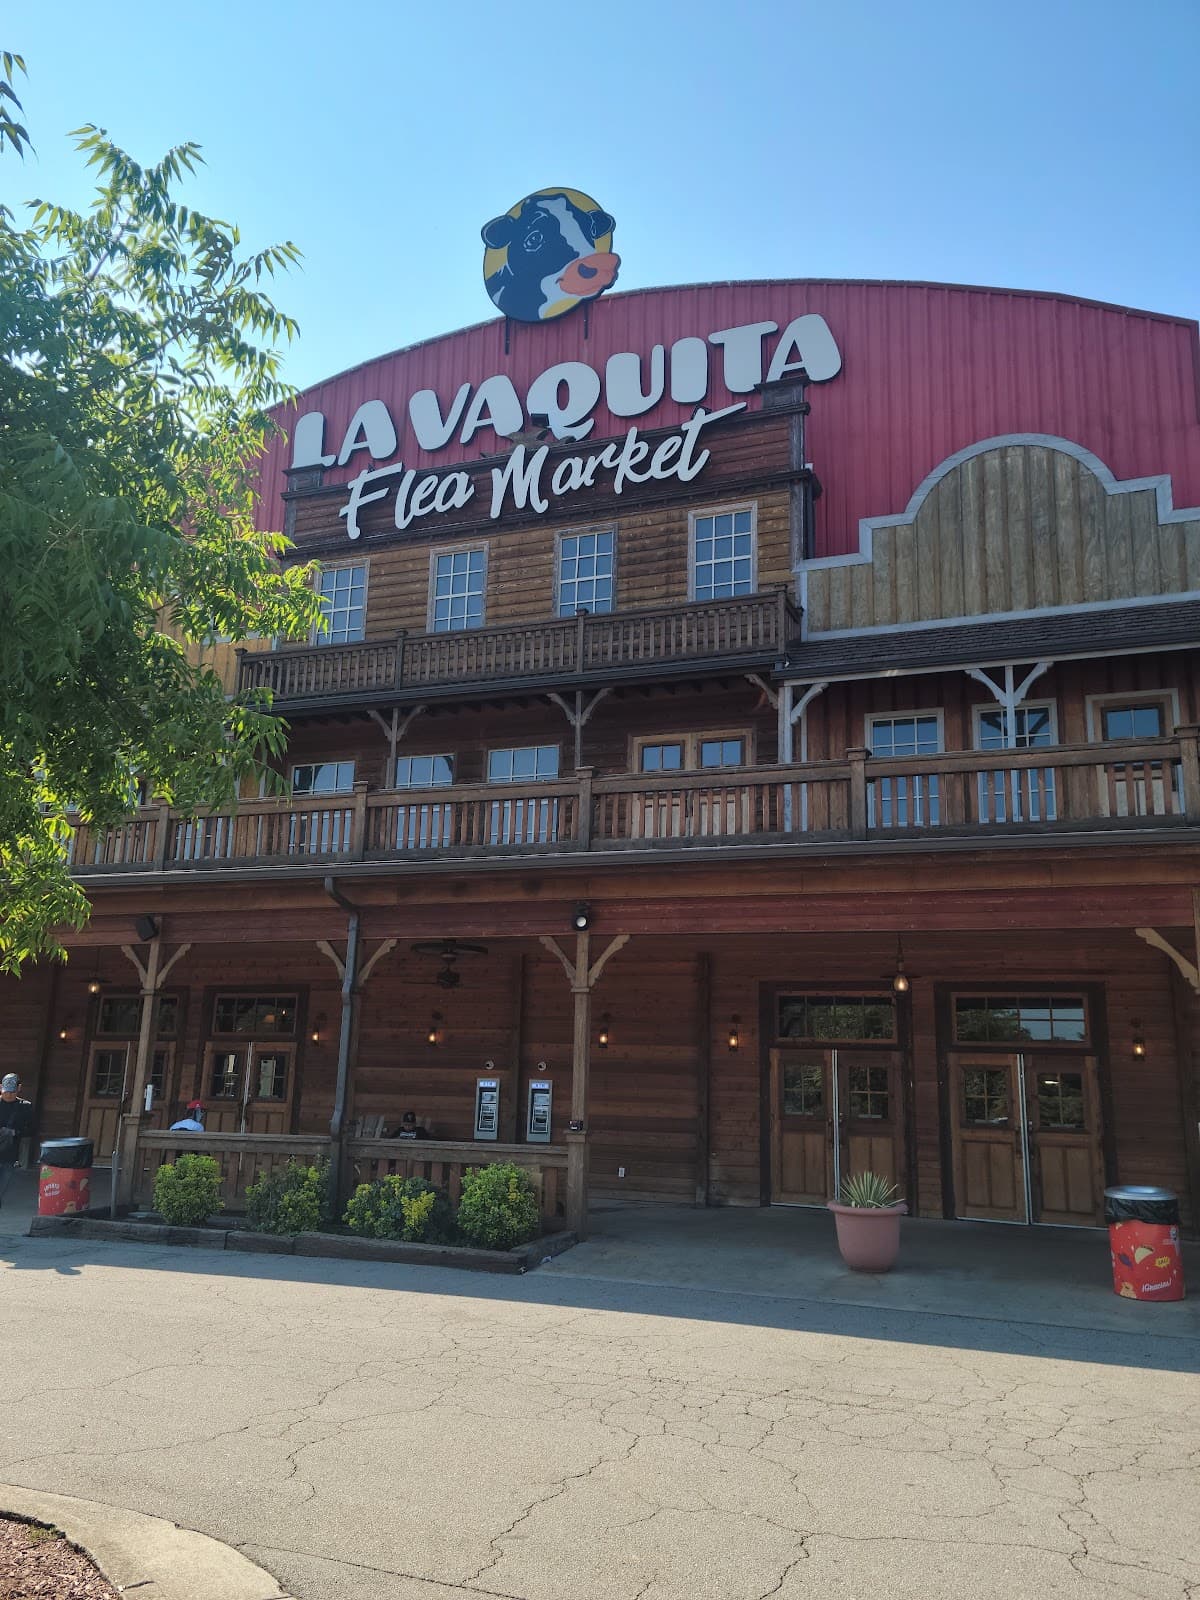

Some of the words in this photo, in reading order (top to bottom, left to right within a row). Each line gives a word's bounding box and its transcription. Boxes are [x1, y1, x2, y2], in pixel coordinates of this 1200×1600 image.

[291, 399, 397, 469] LA
[409, 313, 842, 450] VAQUITA
[340, 462, 476, 539] Flea
[491, 402, 748, 518] Market
